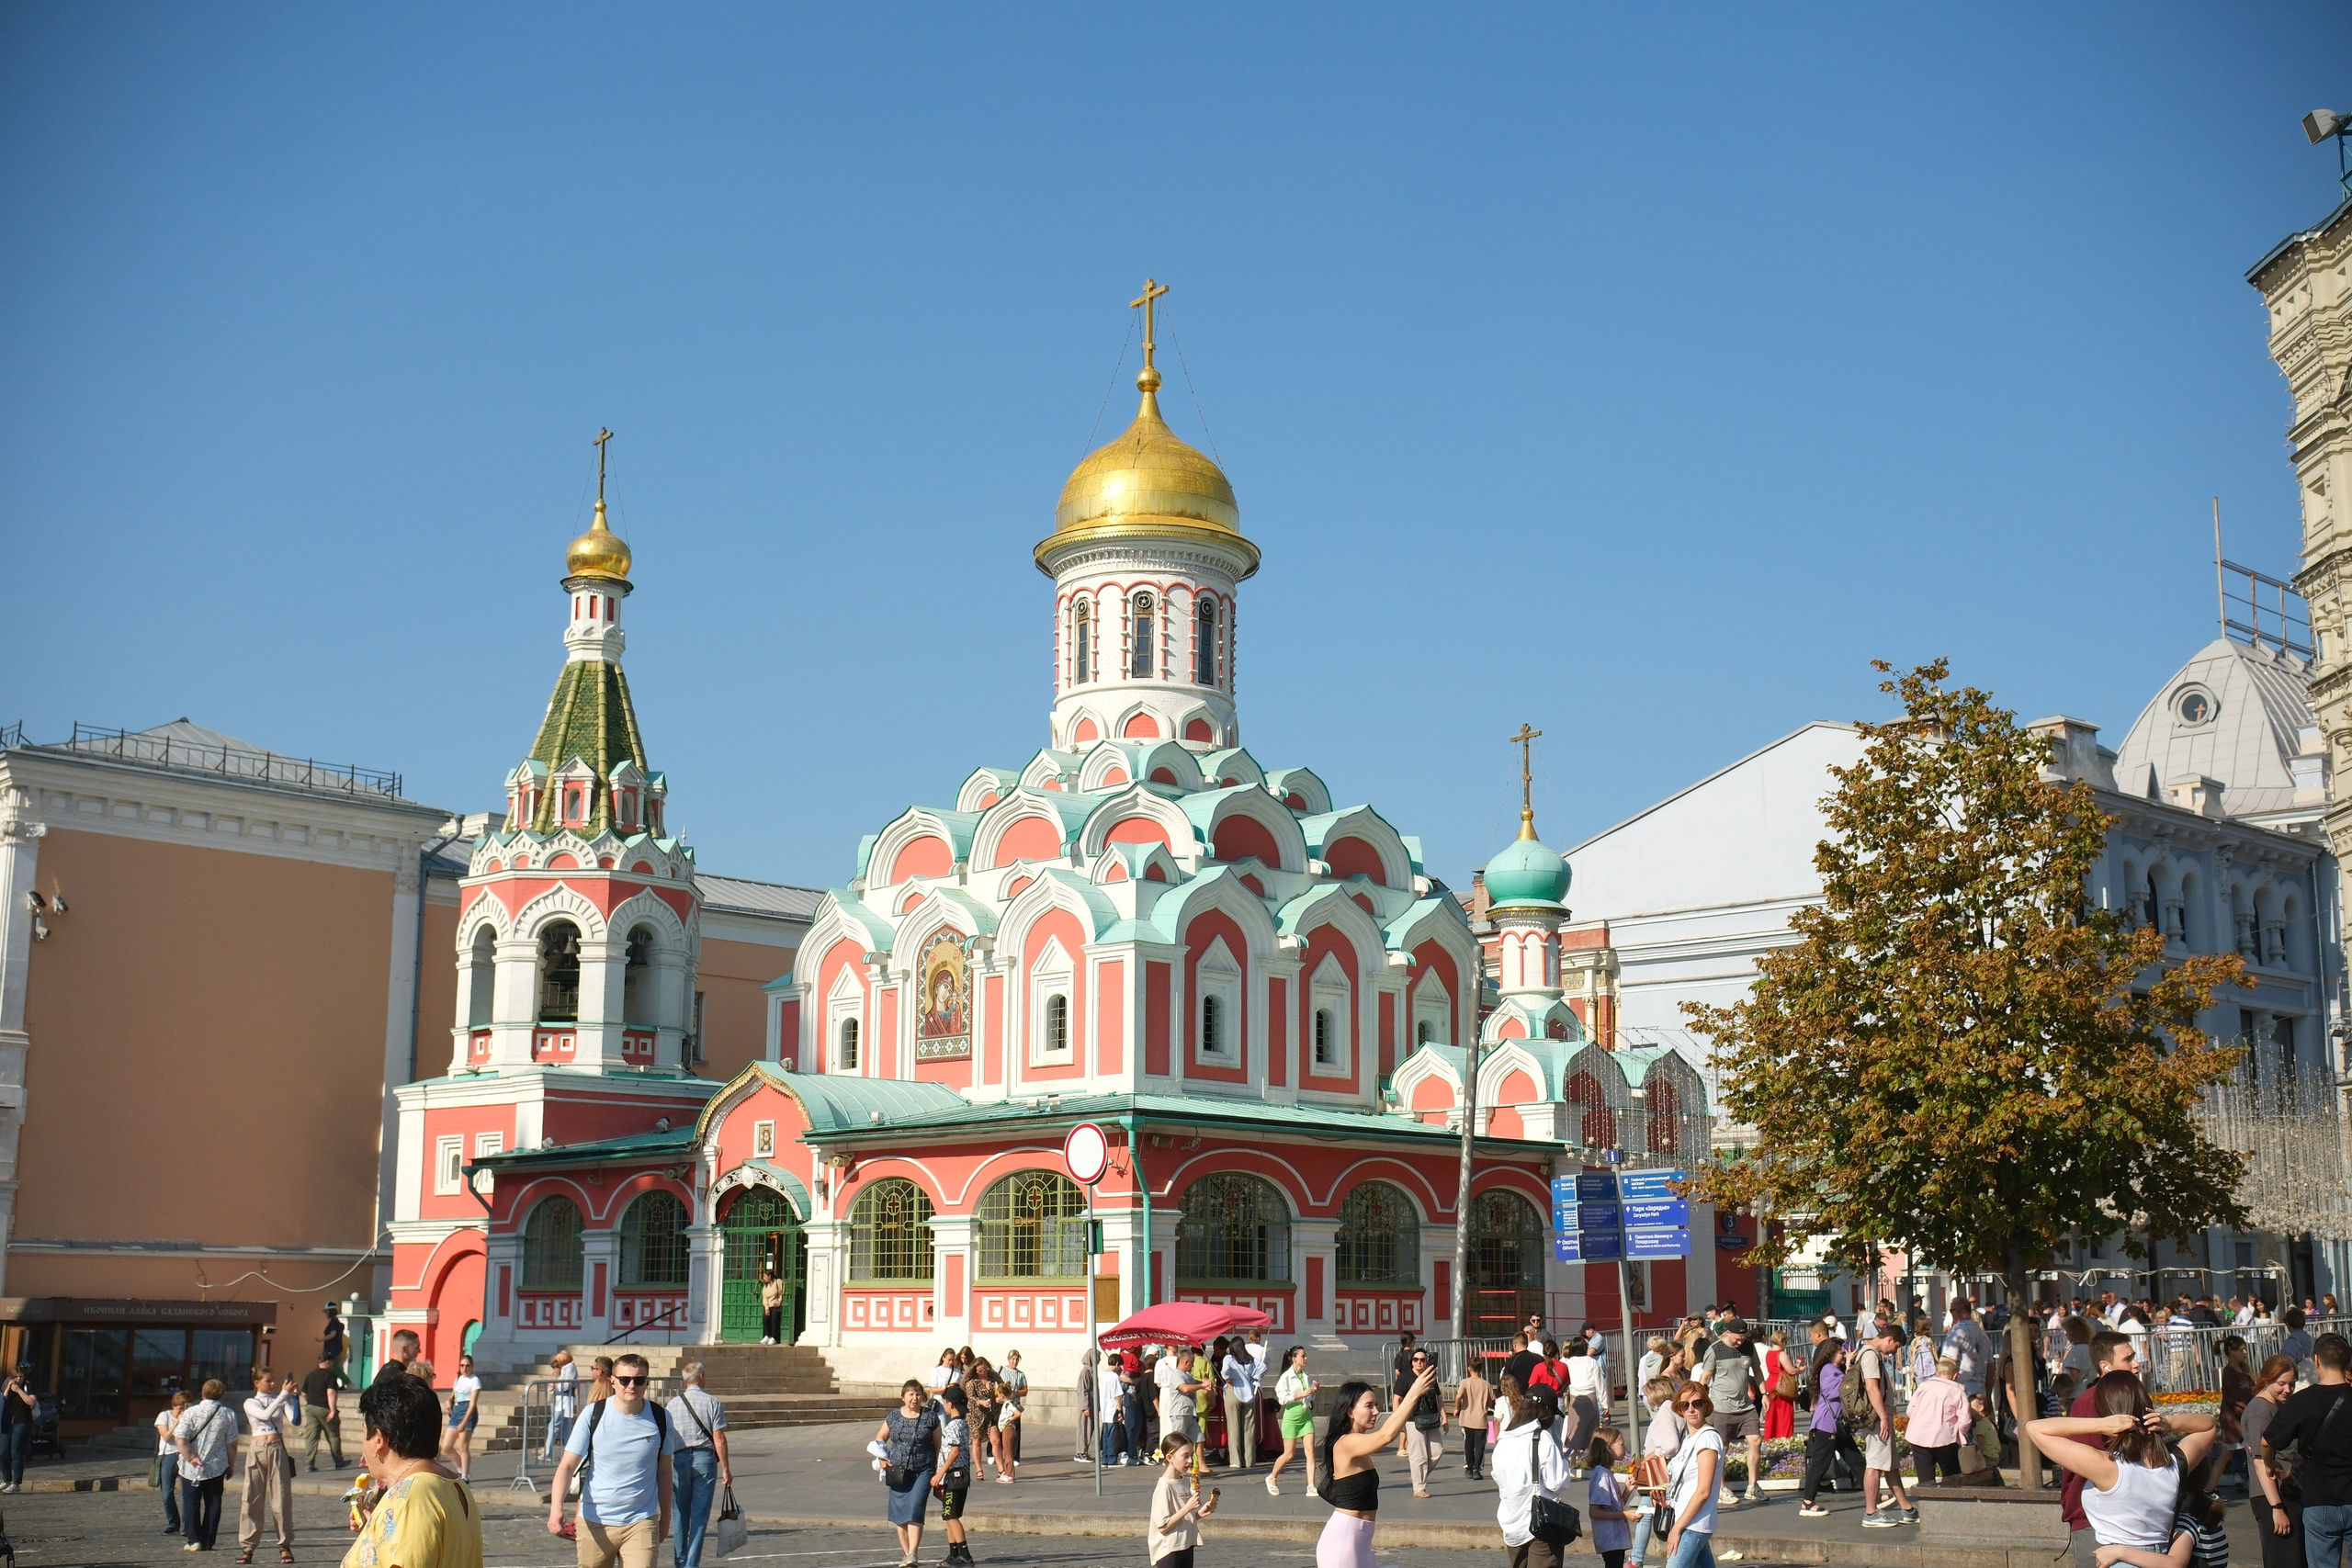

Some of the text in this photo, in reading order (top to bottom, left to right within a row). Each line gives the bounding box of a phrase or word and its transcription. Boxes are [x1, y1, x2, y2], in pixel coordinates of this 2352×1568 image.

[1727, 1215, 1734, 1228] 3
[84, 1306, 126, 1314] ИКОННАЯ
[161, 1308, 214, 1316] КАЗАНСКОГО
